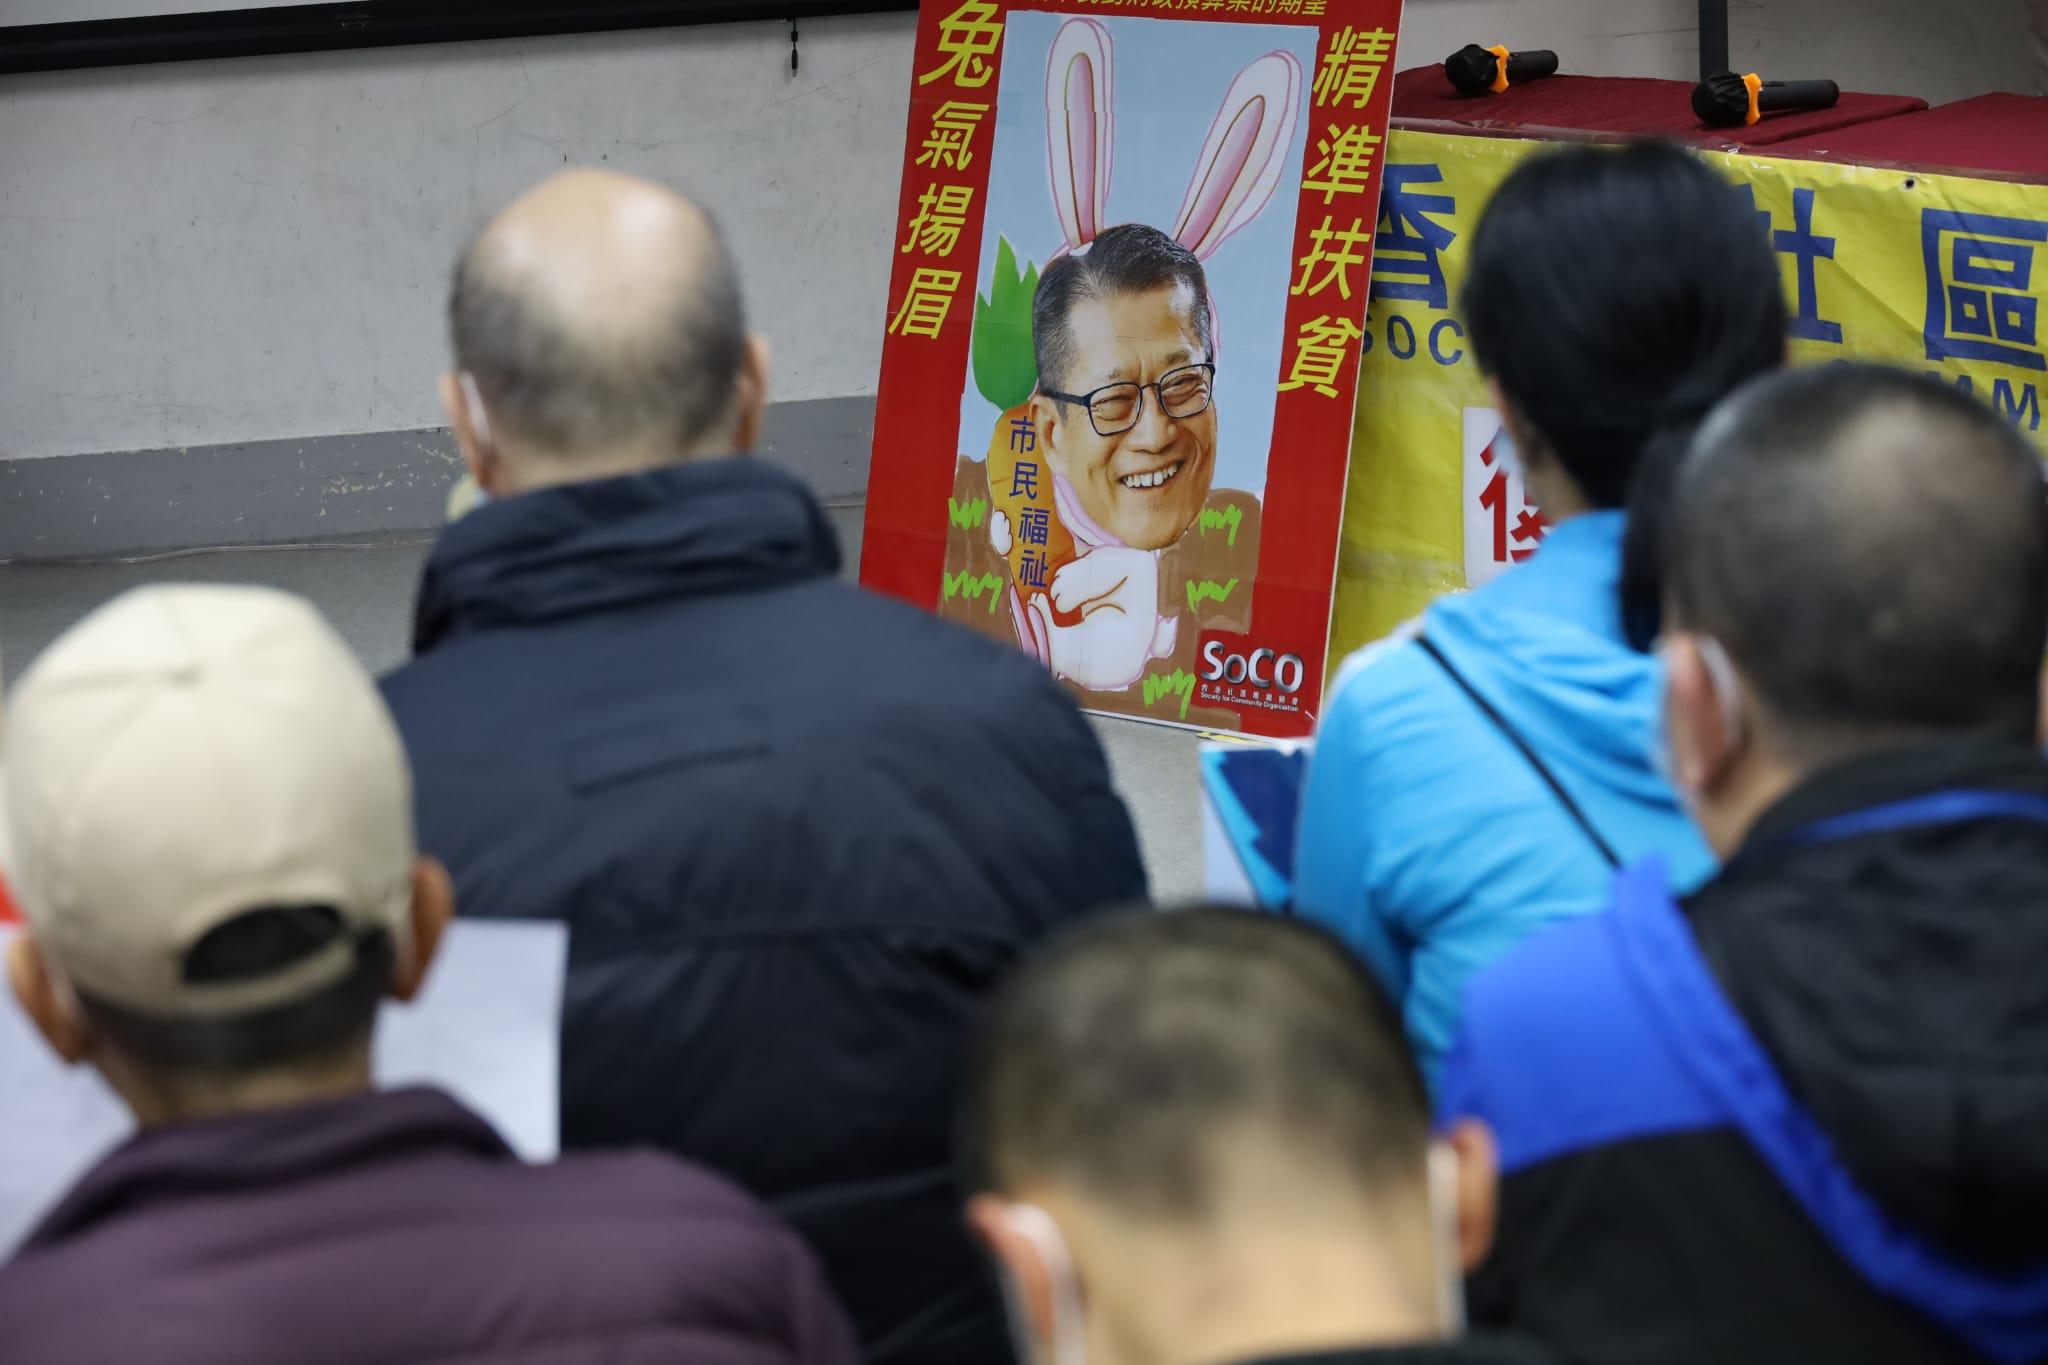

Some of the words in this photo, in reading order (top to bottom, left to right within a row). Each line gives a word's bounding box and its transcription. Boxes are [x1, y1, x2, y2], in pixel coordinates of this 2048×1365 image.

[888, 0, 1004, 339] 兔氣揚眉
[1279, 26, 1395, 398] 精準扶貧
[1009, 416, 1050, 588] 市民福祉
[1201, 640, 1303, 693] SoCO
